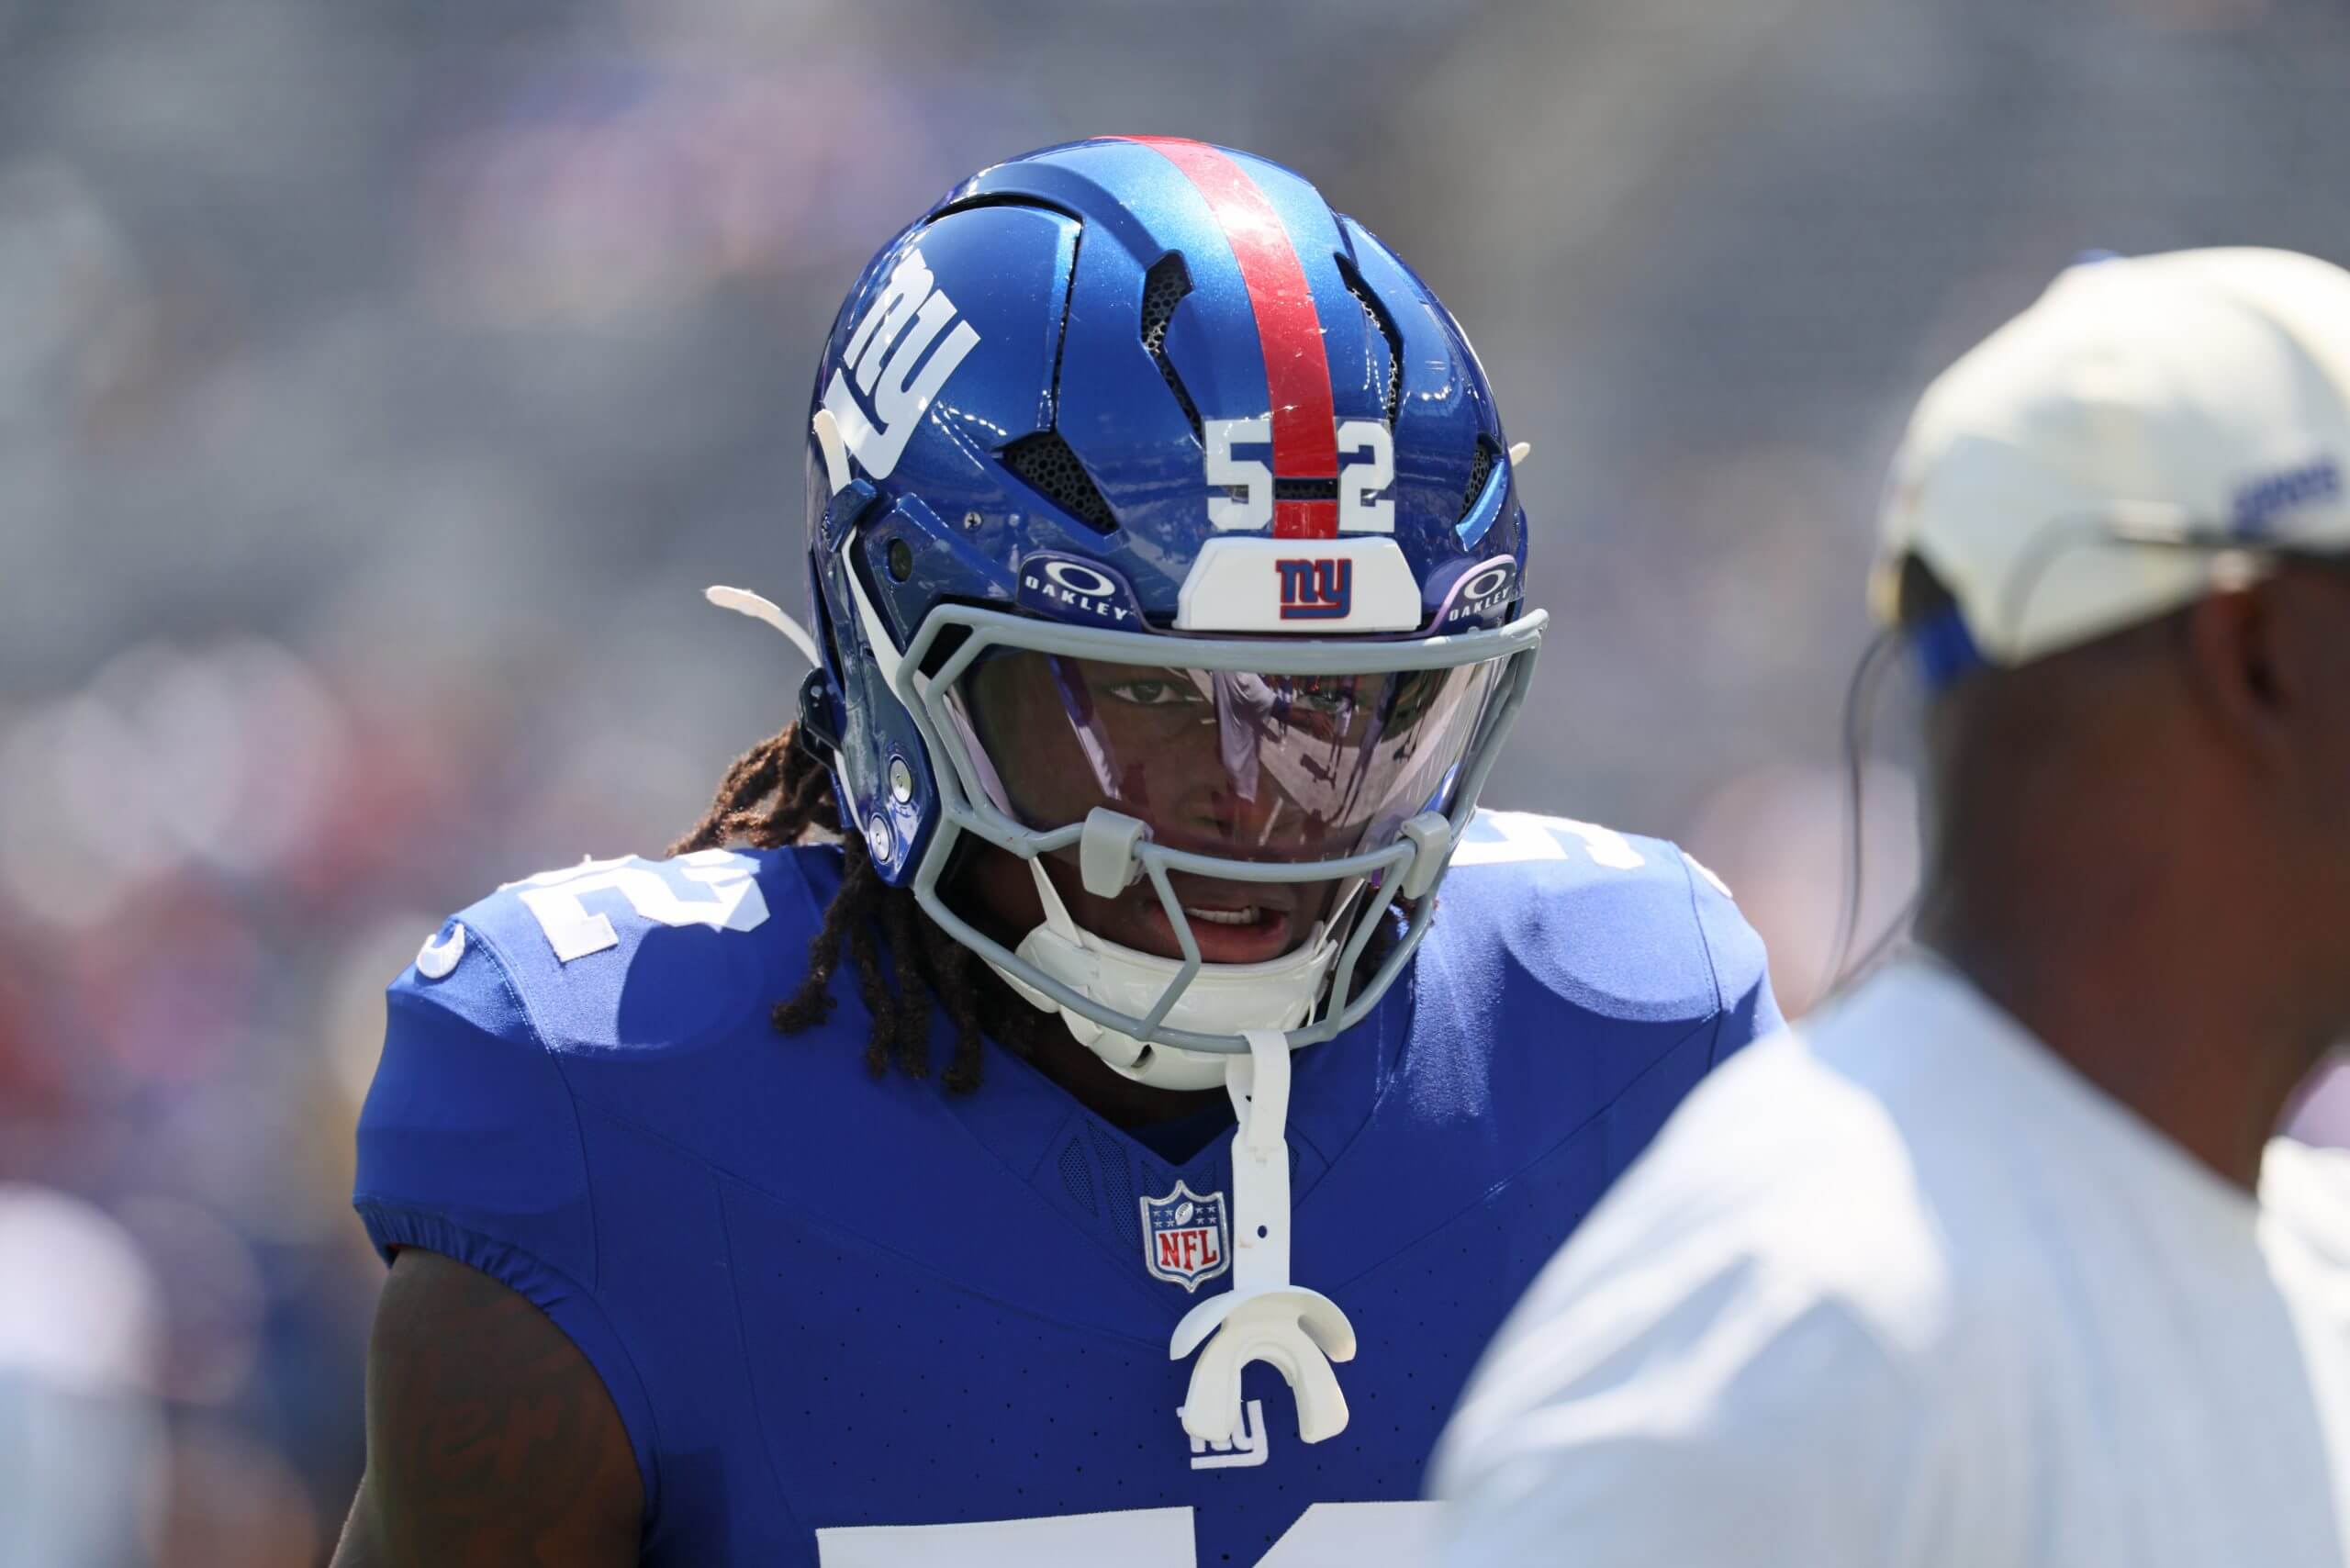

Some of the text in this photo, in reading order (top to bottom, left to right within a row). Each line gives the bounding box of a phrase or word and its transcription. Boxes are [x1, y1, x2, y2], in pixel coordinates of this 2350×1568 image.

[1204, 419, 1395, 533] 52
[1025, 576, 1128, 621] OAKLEY
[1449, 587, 1510, 622] OAKLEY
[1158, 1230, 1217, 1271] NFL
